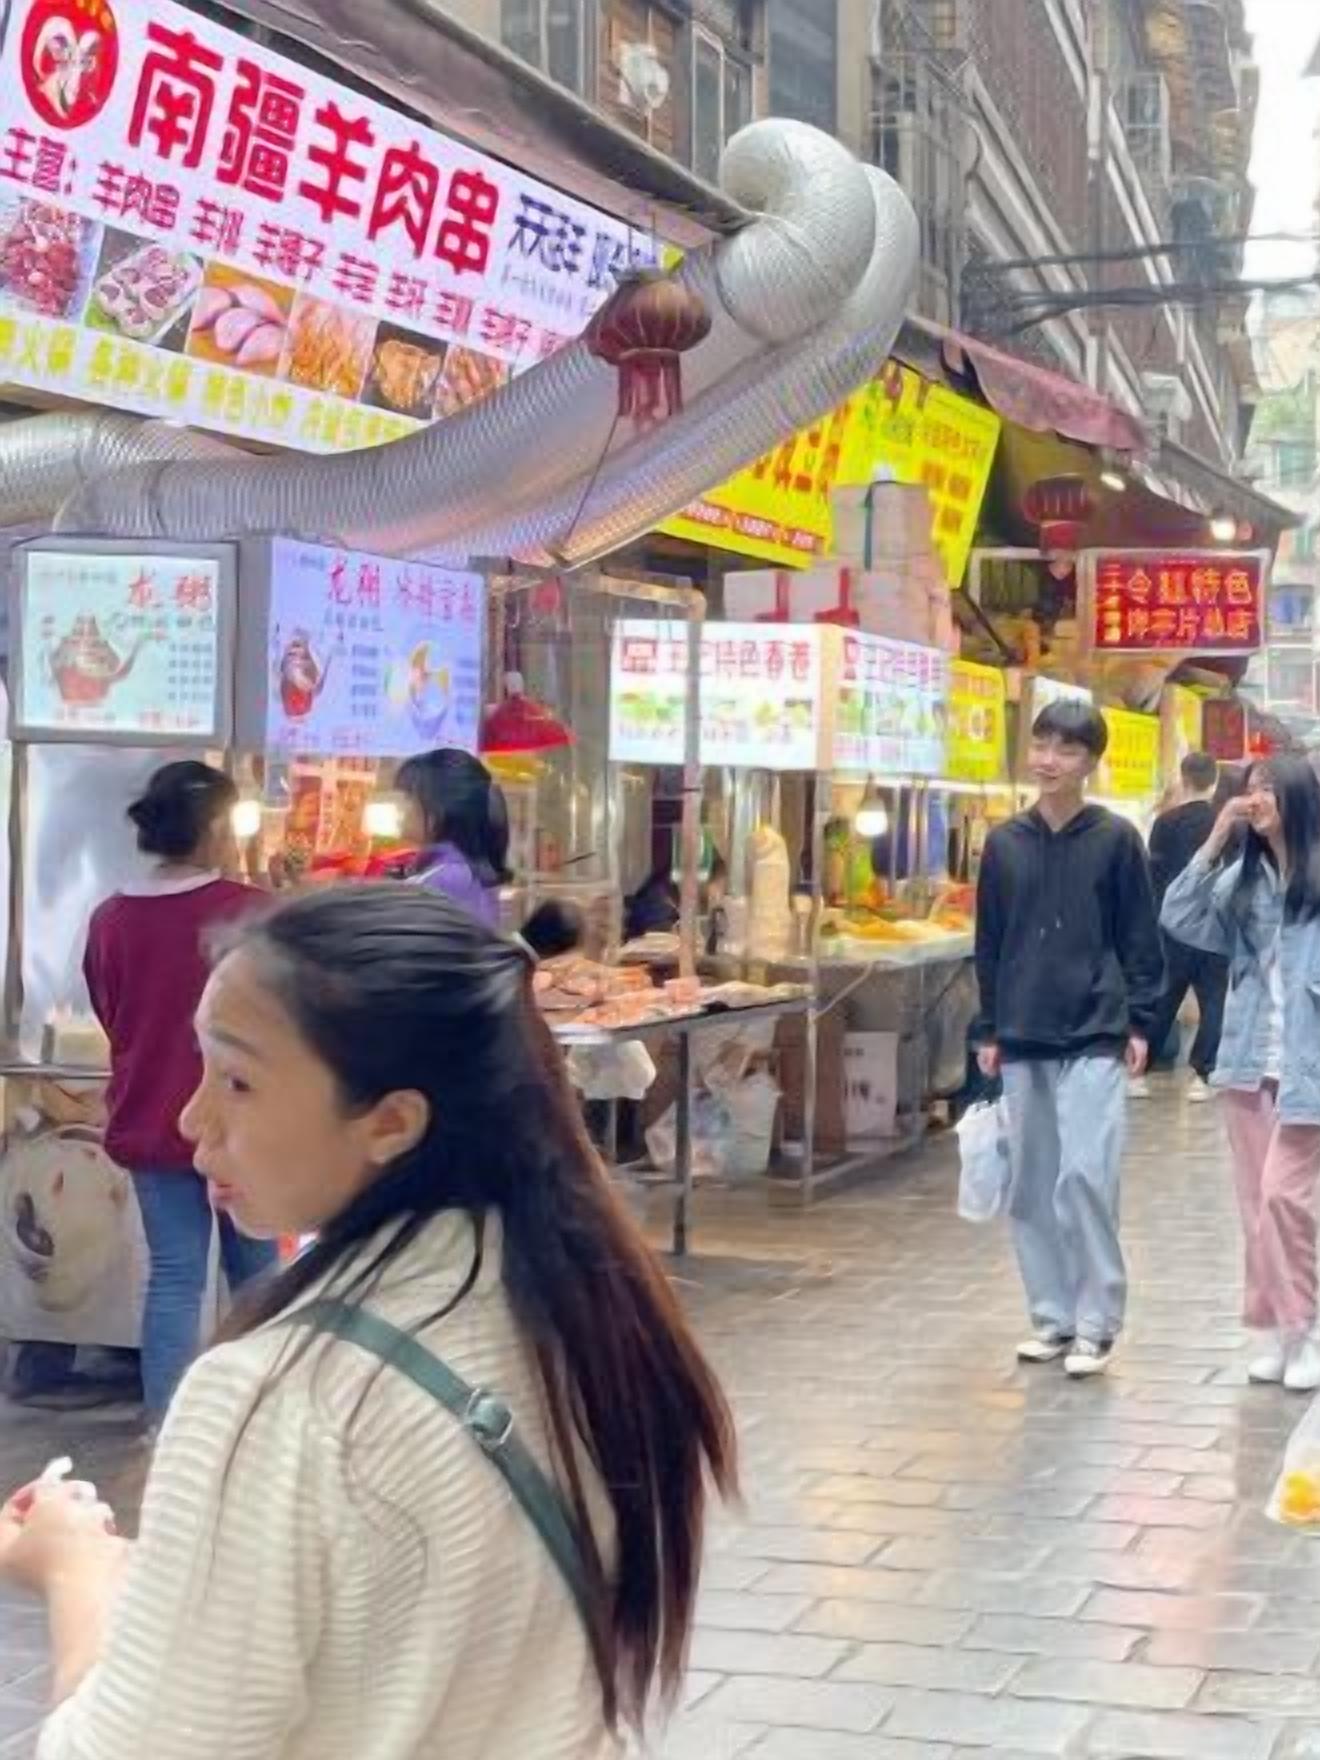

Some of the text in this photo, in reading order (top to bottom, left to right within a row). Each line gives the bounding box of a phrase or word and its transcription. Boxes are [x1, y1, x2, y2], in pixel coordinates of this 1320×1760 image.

[127, 20, 500, 278] 南疆羊肉串
